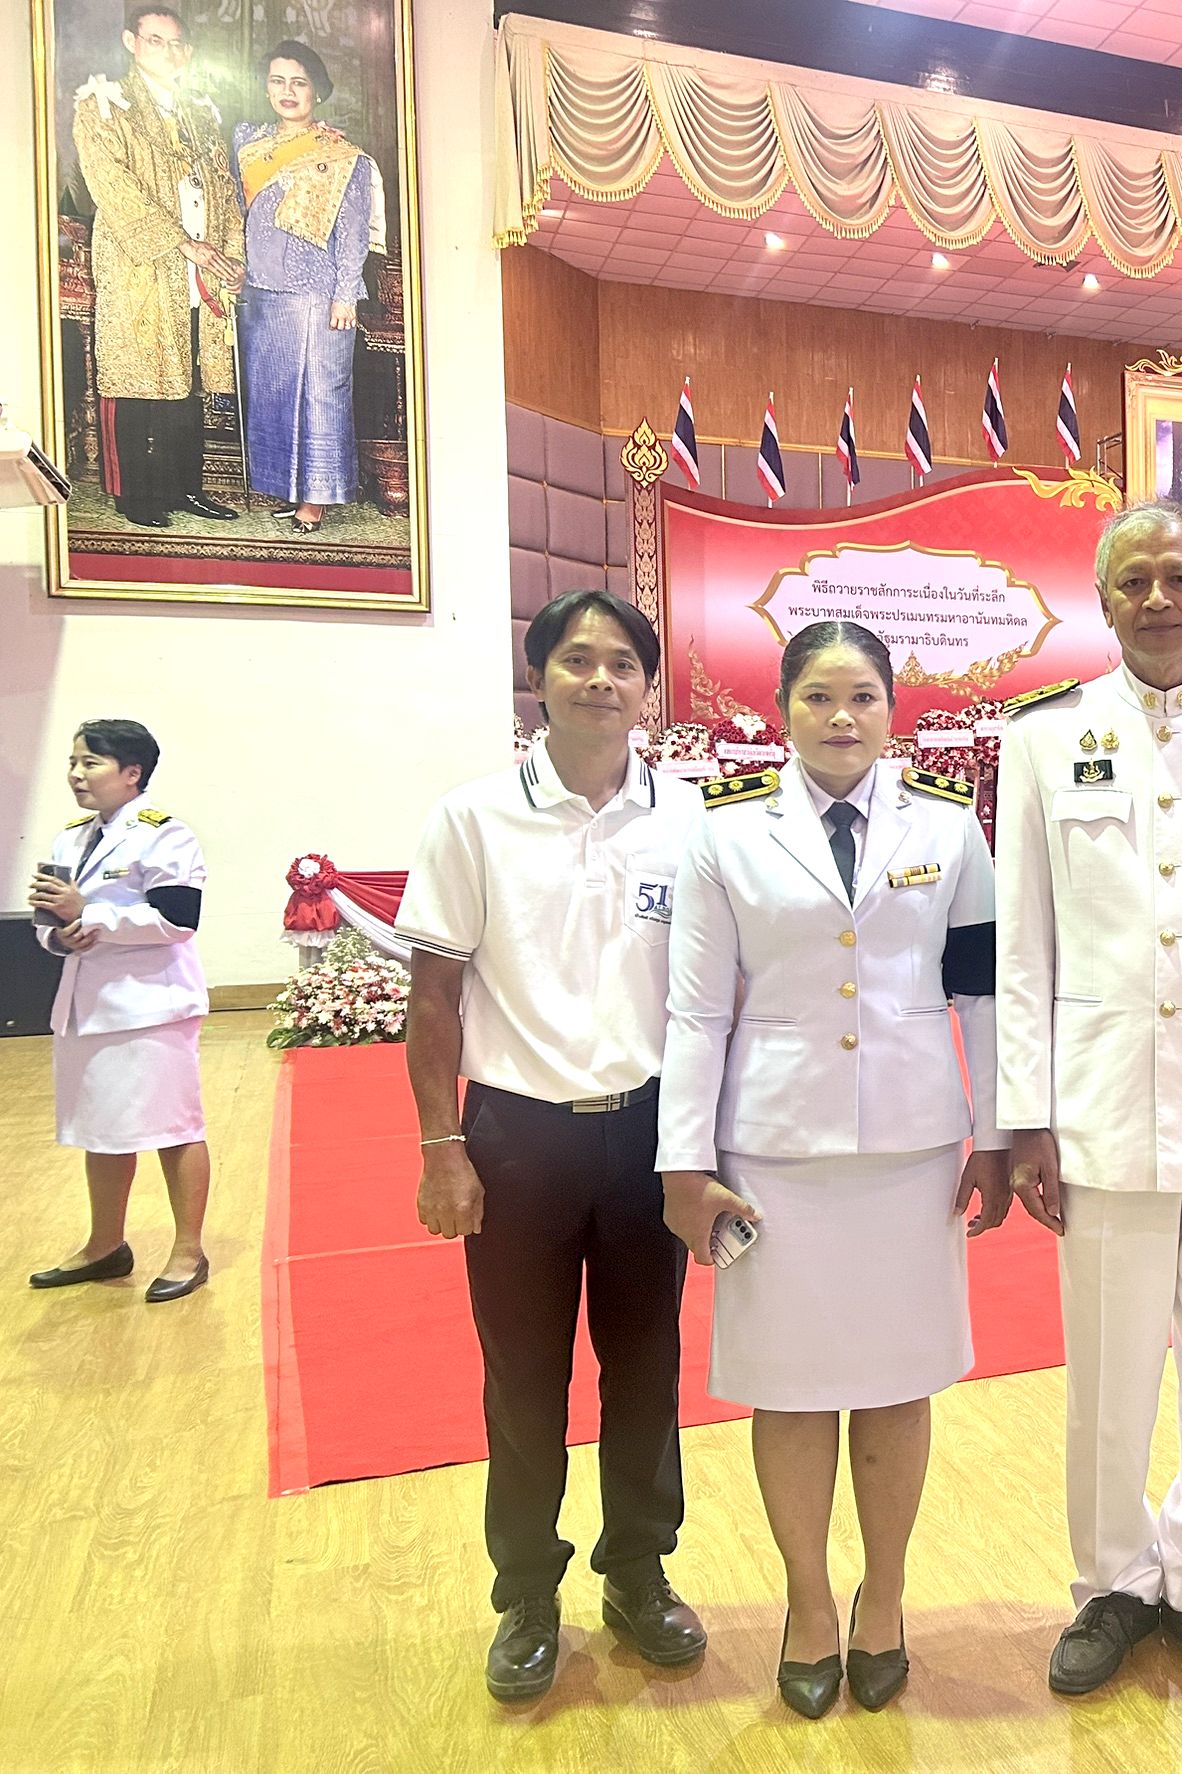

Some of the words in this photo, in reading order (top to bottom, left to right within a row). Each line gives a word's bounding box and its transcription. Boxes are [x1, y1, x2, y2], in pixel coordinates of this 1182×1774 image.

[811, 579, 1005, 602] พิธีถวายราชสักการะเนื่องในวันที่ระลึก
[636, 882, 668, 912] 51
